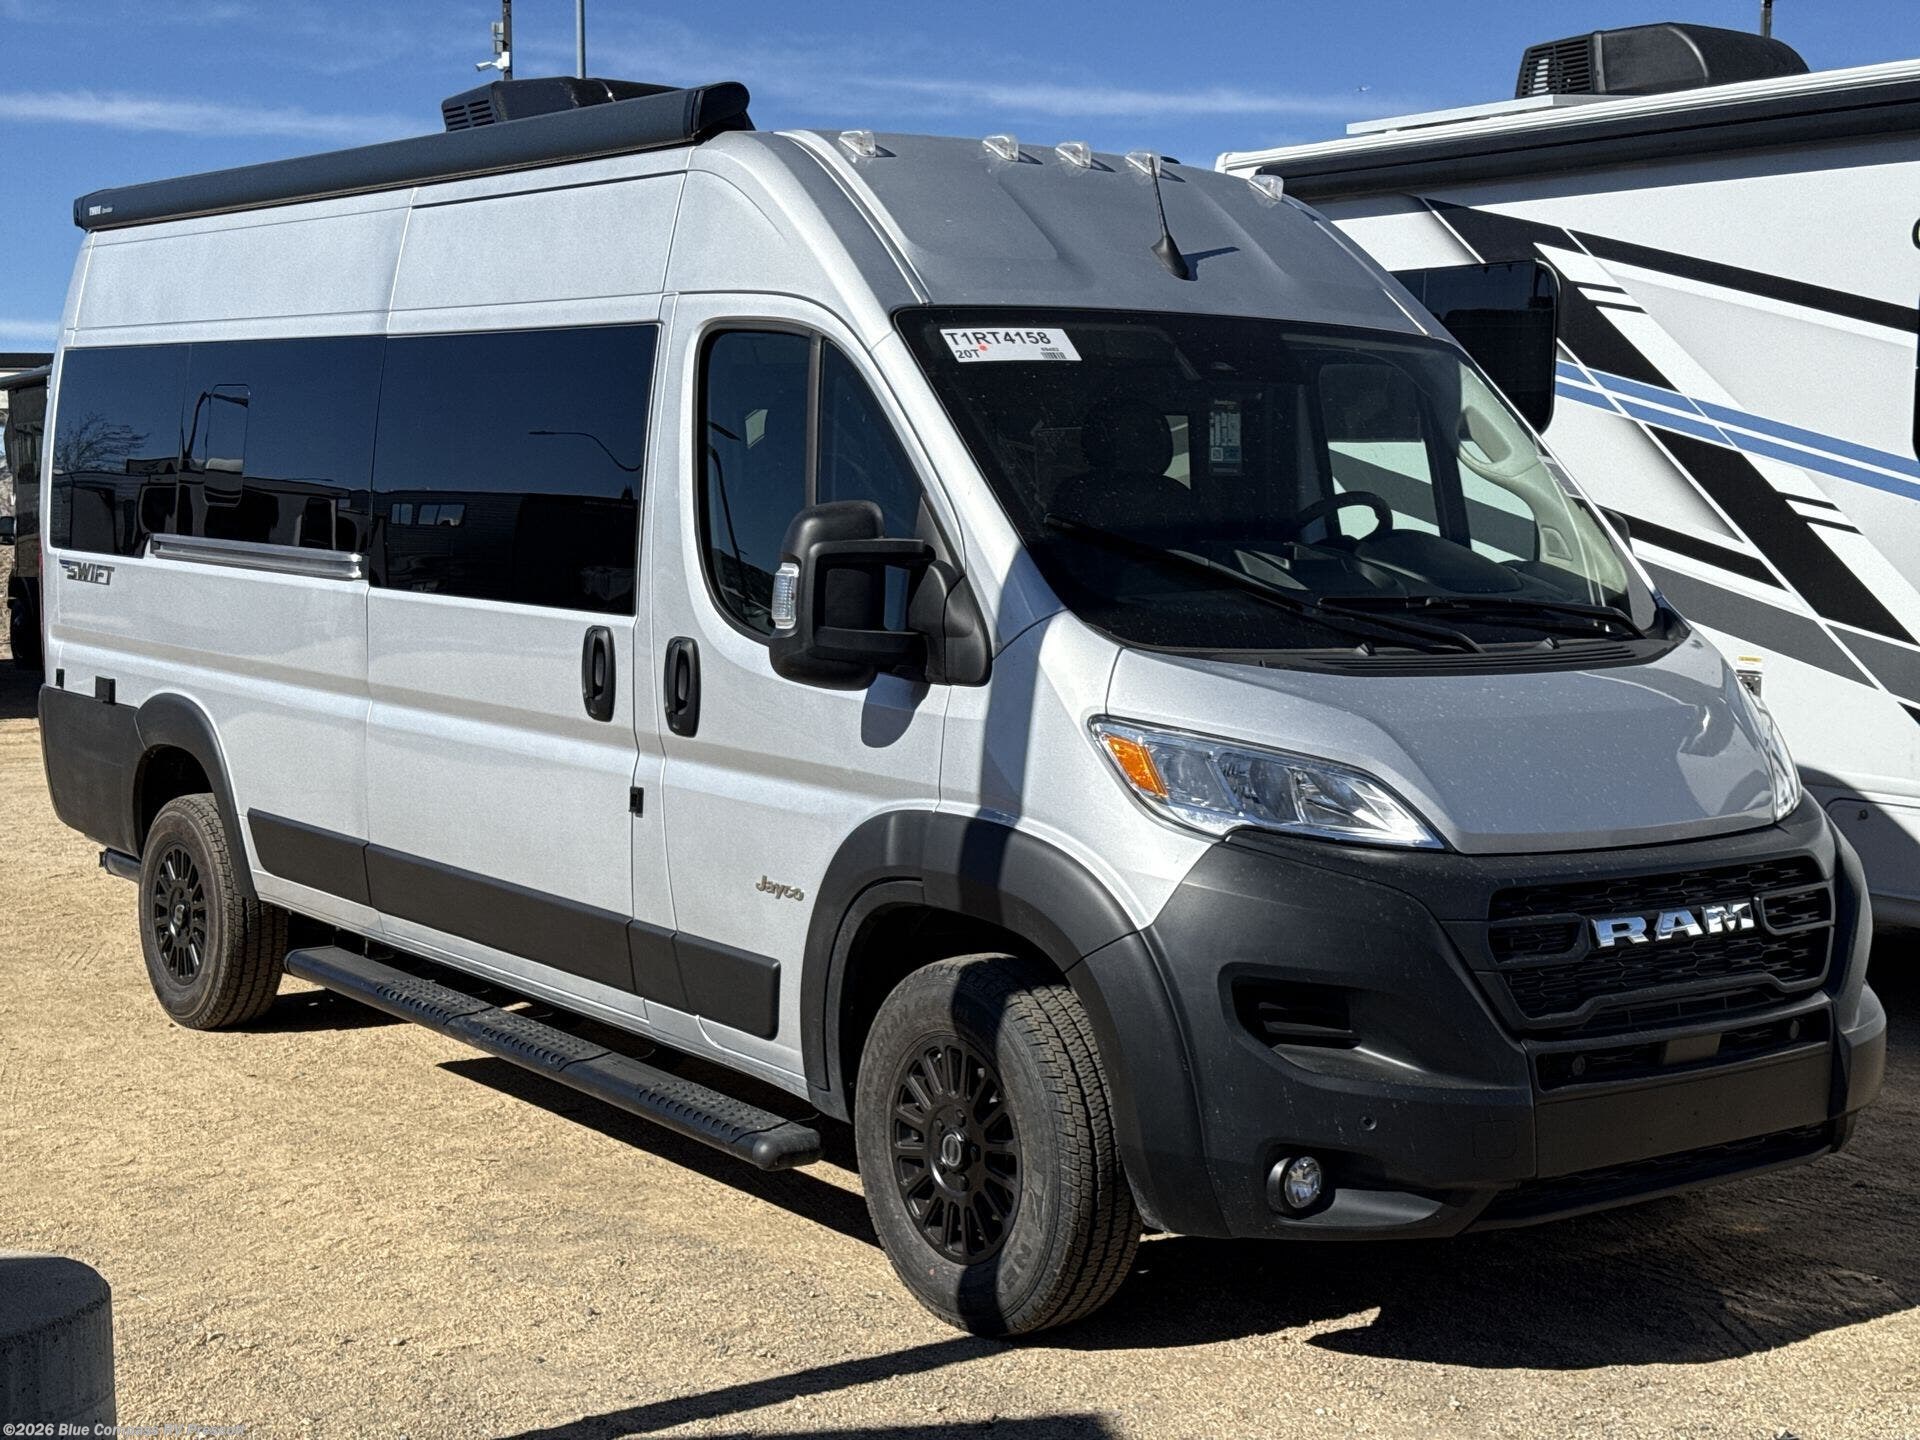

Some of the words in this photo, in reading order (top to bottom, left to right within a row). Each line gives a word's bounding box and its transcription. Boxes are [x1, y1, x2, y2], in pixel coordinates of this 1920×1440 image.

[945, 331, 1051, 345] T1RT4158
[955, 349, 980, 359] 20T
[60, 559, 115, 585] SWIFT
[756, 875, 804, 901] Jayco
[1591, 902, 1755, 948] RAM
